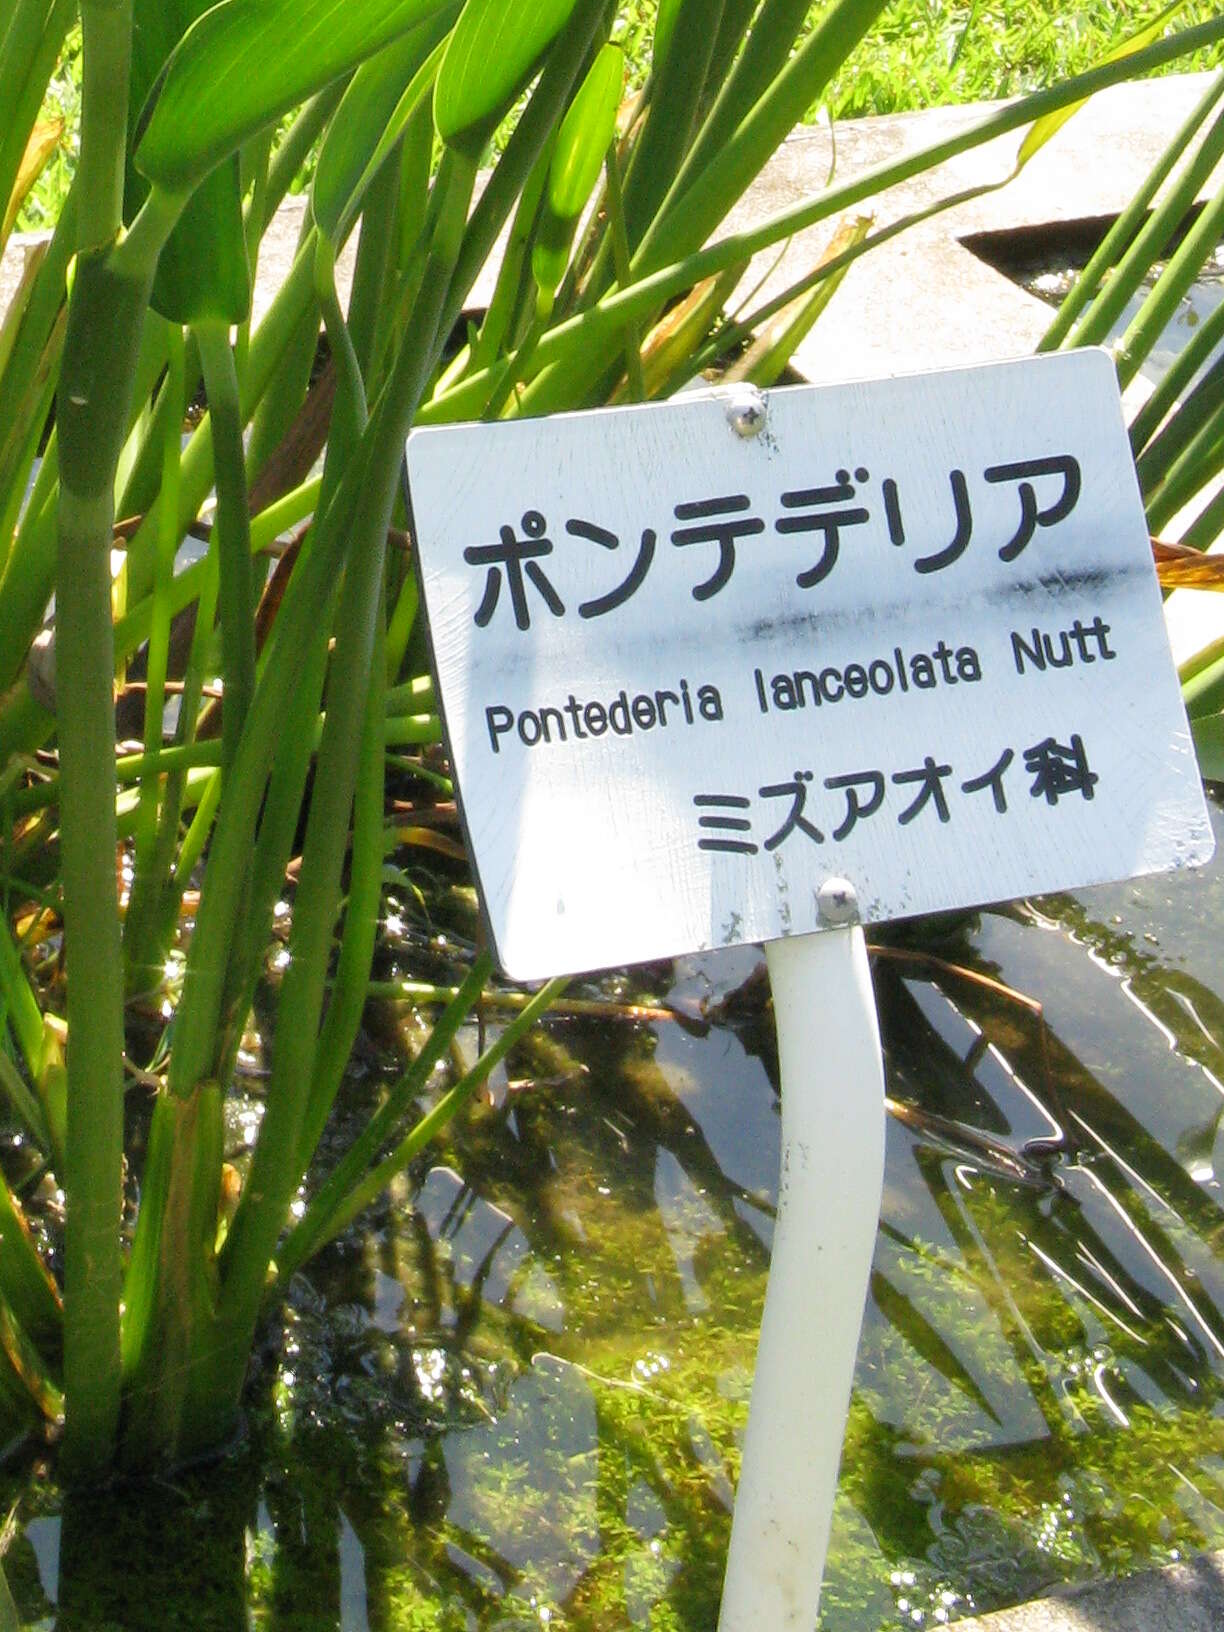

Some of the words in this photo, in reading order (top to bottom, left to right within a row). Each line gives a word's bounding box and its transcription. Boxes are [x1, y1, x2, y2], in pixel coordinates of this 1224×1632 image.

[463, 454, 1082, 631] ポンテデリア
[485, 680, 724, 753] Pontederia
[754, 641, 982, 713] lanceolata
[1011, 616, 1116, 677] Nutt
[693, 734, 1099, 856] ミズアオイ科
